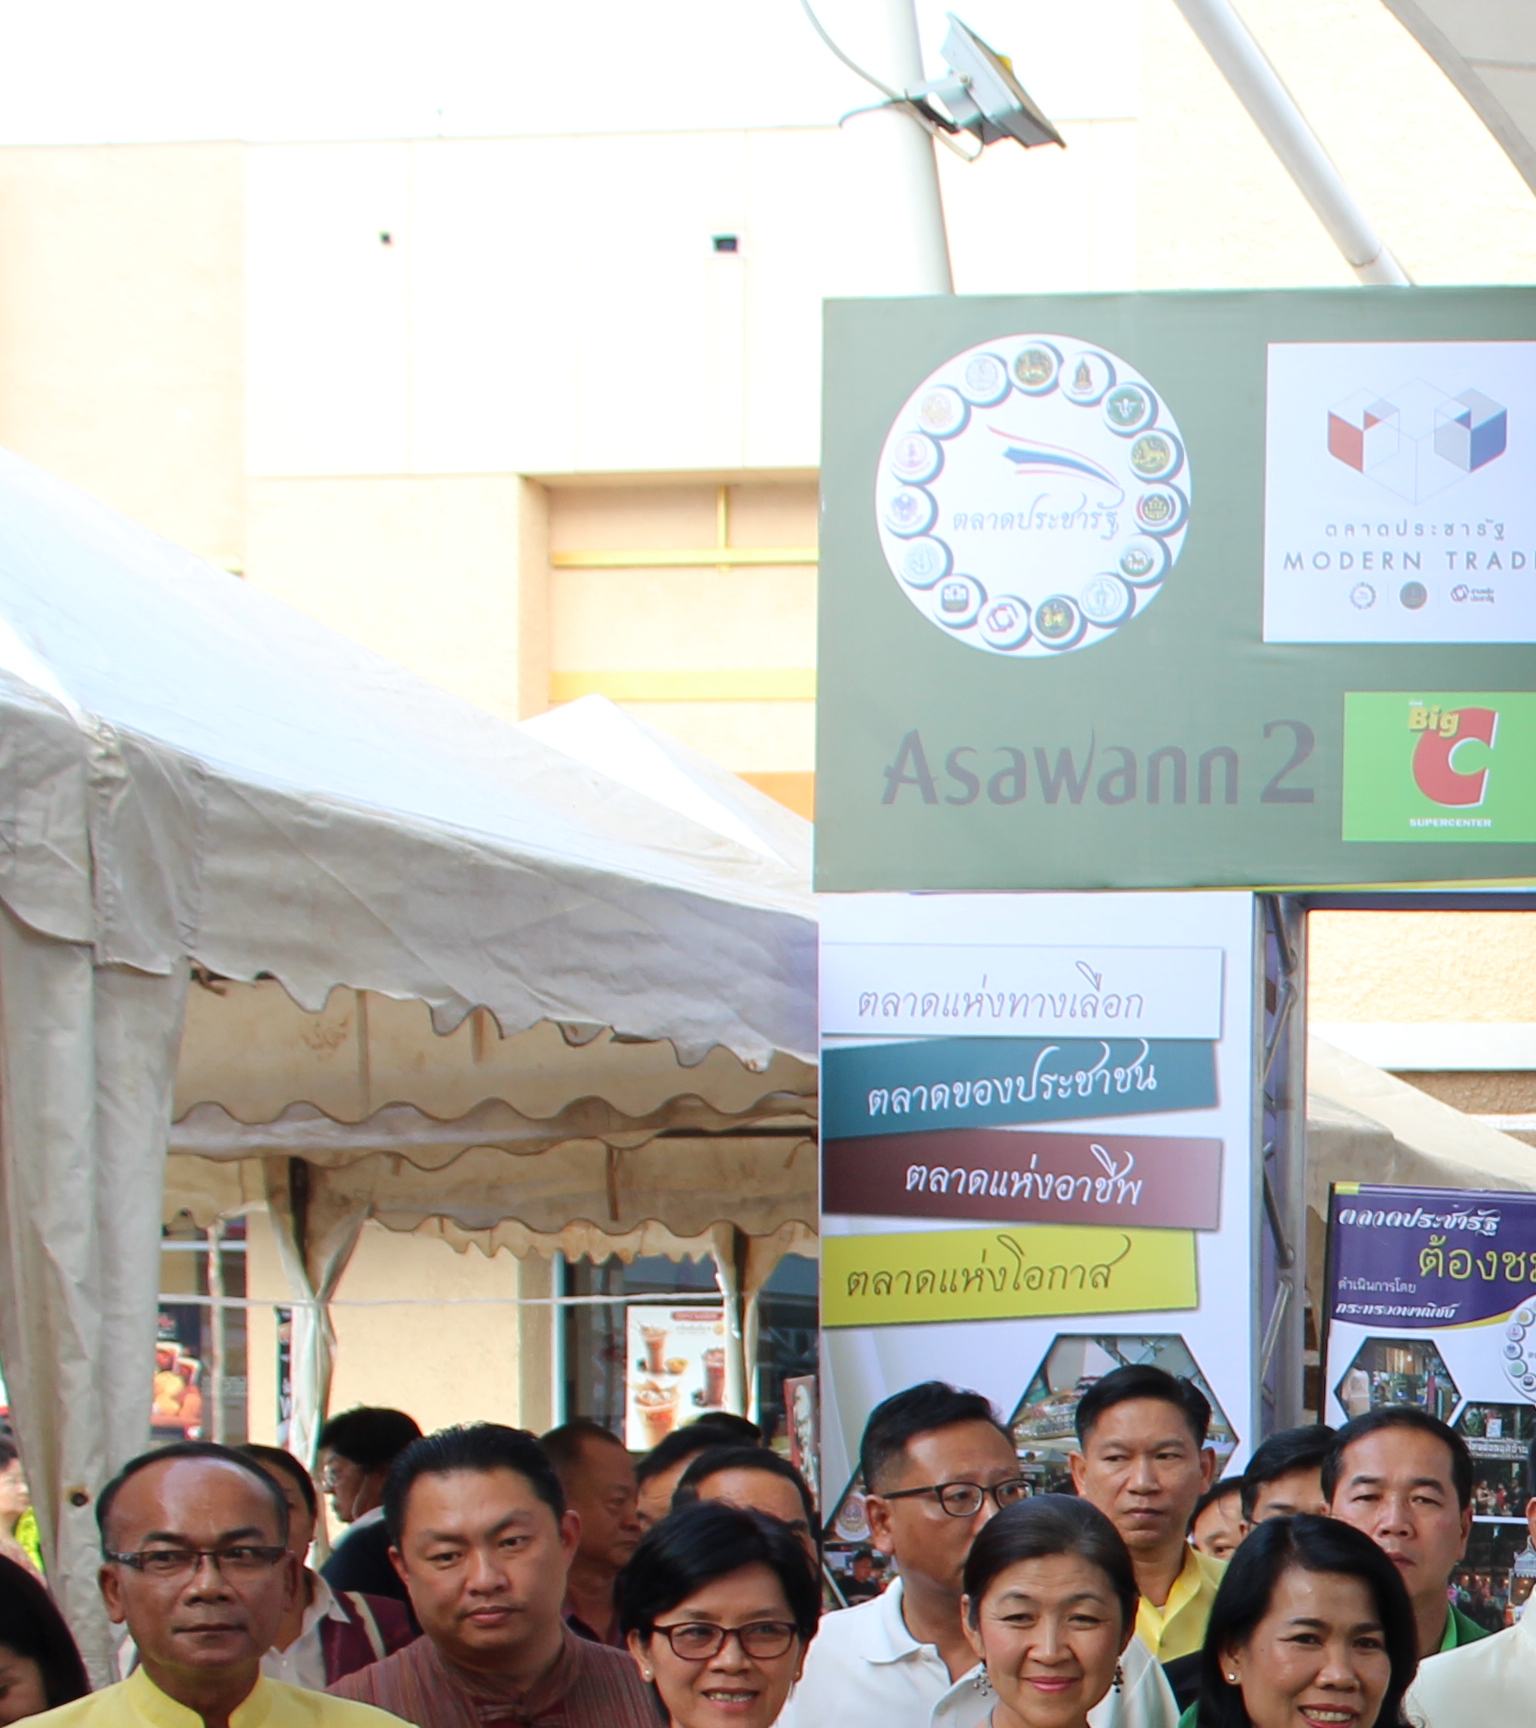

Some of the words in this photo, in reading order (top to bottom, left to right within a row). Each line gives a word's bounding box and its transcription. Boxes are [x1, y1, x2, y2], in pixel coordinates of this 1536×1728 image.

[953, 492, 1122, 541] ตลาดประชารัฐ
[1324, 518, 1505, 541] ตลาดประชารัฐ
[1283, 550, 1423, 571] MODERN
[1407, 704, 1461, 738] Big
[881, 722, 1240, 806] Asawann
[1259, 718, 1316, 804] 2
[1412, 706, 1499, 809] C
[1409, 818, 1492, 828] SUPERCENTER
[858, 960, 1144, 1019] ตลาดแห่งทางเลือก
[868, 1038, 1158, 1117] ตลาดของประชาชน
[905, 1143, 1144, 1206] ตลาดแห่งอาชีพ
[1338, 1205, 1500, 1237] ตลาดประชารัฐ
[847, 1234, 1131, 1297] ตลาดแห่งโอกาส
[1338, 1277, 1417, 1294] ดำเนินการโดย
